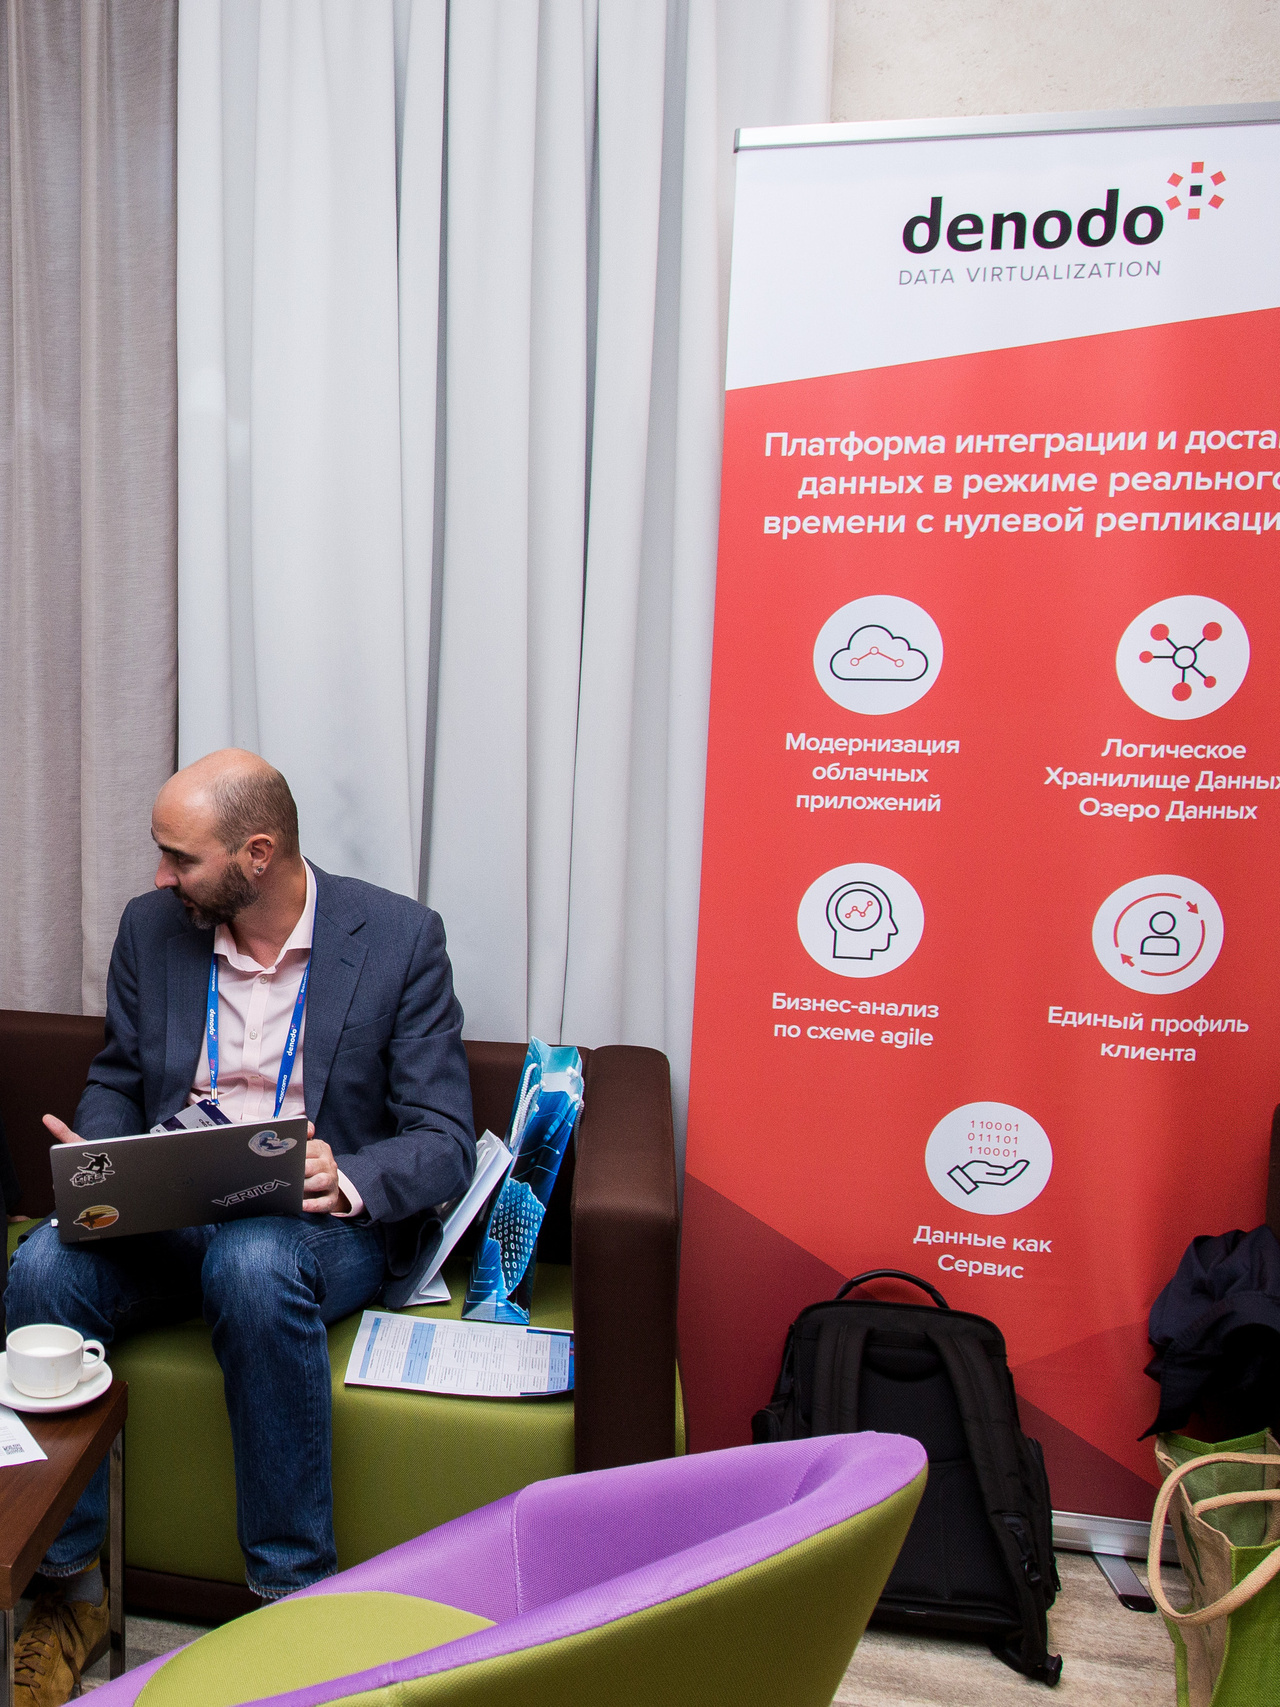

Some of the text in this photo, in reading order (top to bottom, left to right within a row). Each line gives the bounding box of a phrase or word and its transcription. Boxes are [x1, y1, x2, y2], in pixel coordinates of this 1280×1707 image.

[903, 189, 1163, 254] denodo
[899, 261, 1160, 285] DATA VIRTUALIZATION
[765, 430, 1280, 461] Платформа интеграции и доста
[798, 475, 924, 499] данных
[934, 475, 952, 493] в
[963, 473, 1097, 499] режиме
[764, 515, 905, 539] времени
[917, 514, 934, 533] с
[945, 507, 1084, 539] нулевой
[786, 733, 959, 756] Модернизация
[1101, 739, 1246, 759] Логическое
[812, 763, 928, 782] облачных
[1044, 767, 1190, 791] Хранилище
[797, 794, 941, 812] приложений
[1079, 798, 1257, 822] Озеро Данных
[772, 993, 939, 1018] Бизнес-анализ
[1048, 1006, 1249, 1036] Единый профиль
[286, 1027, 298, 1057] denodo
[774, 1025, 933, 1049] по схеме agile
[1101, 1043, 1196, 1061] клиента
[211, 1179, 291, 1207] VERTICA
[913, 1226, 1052, 1252] Данные как
[938, 1254, 1024, 1278] Сервис
